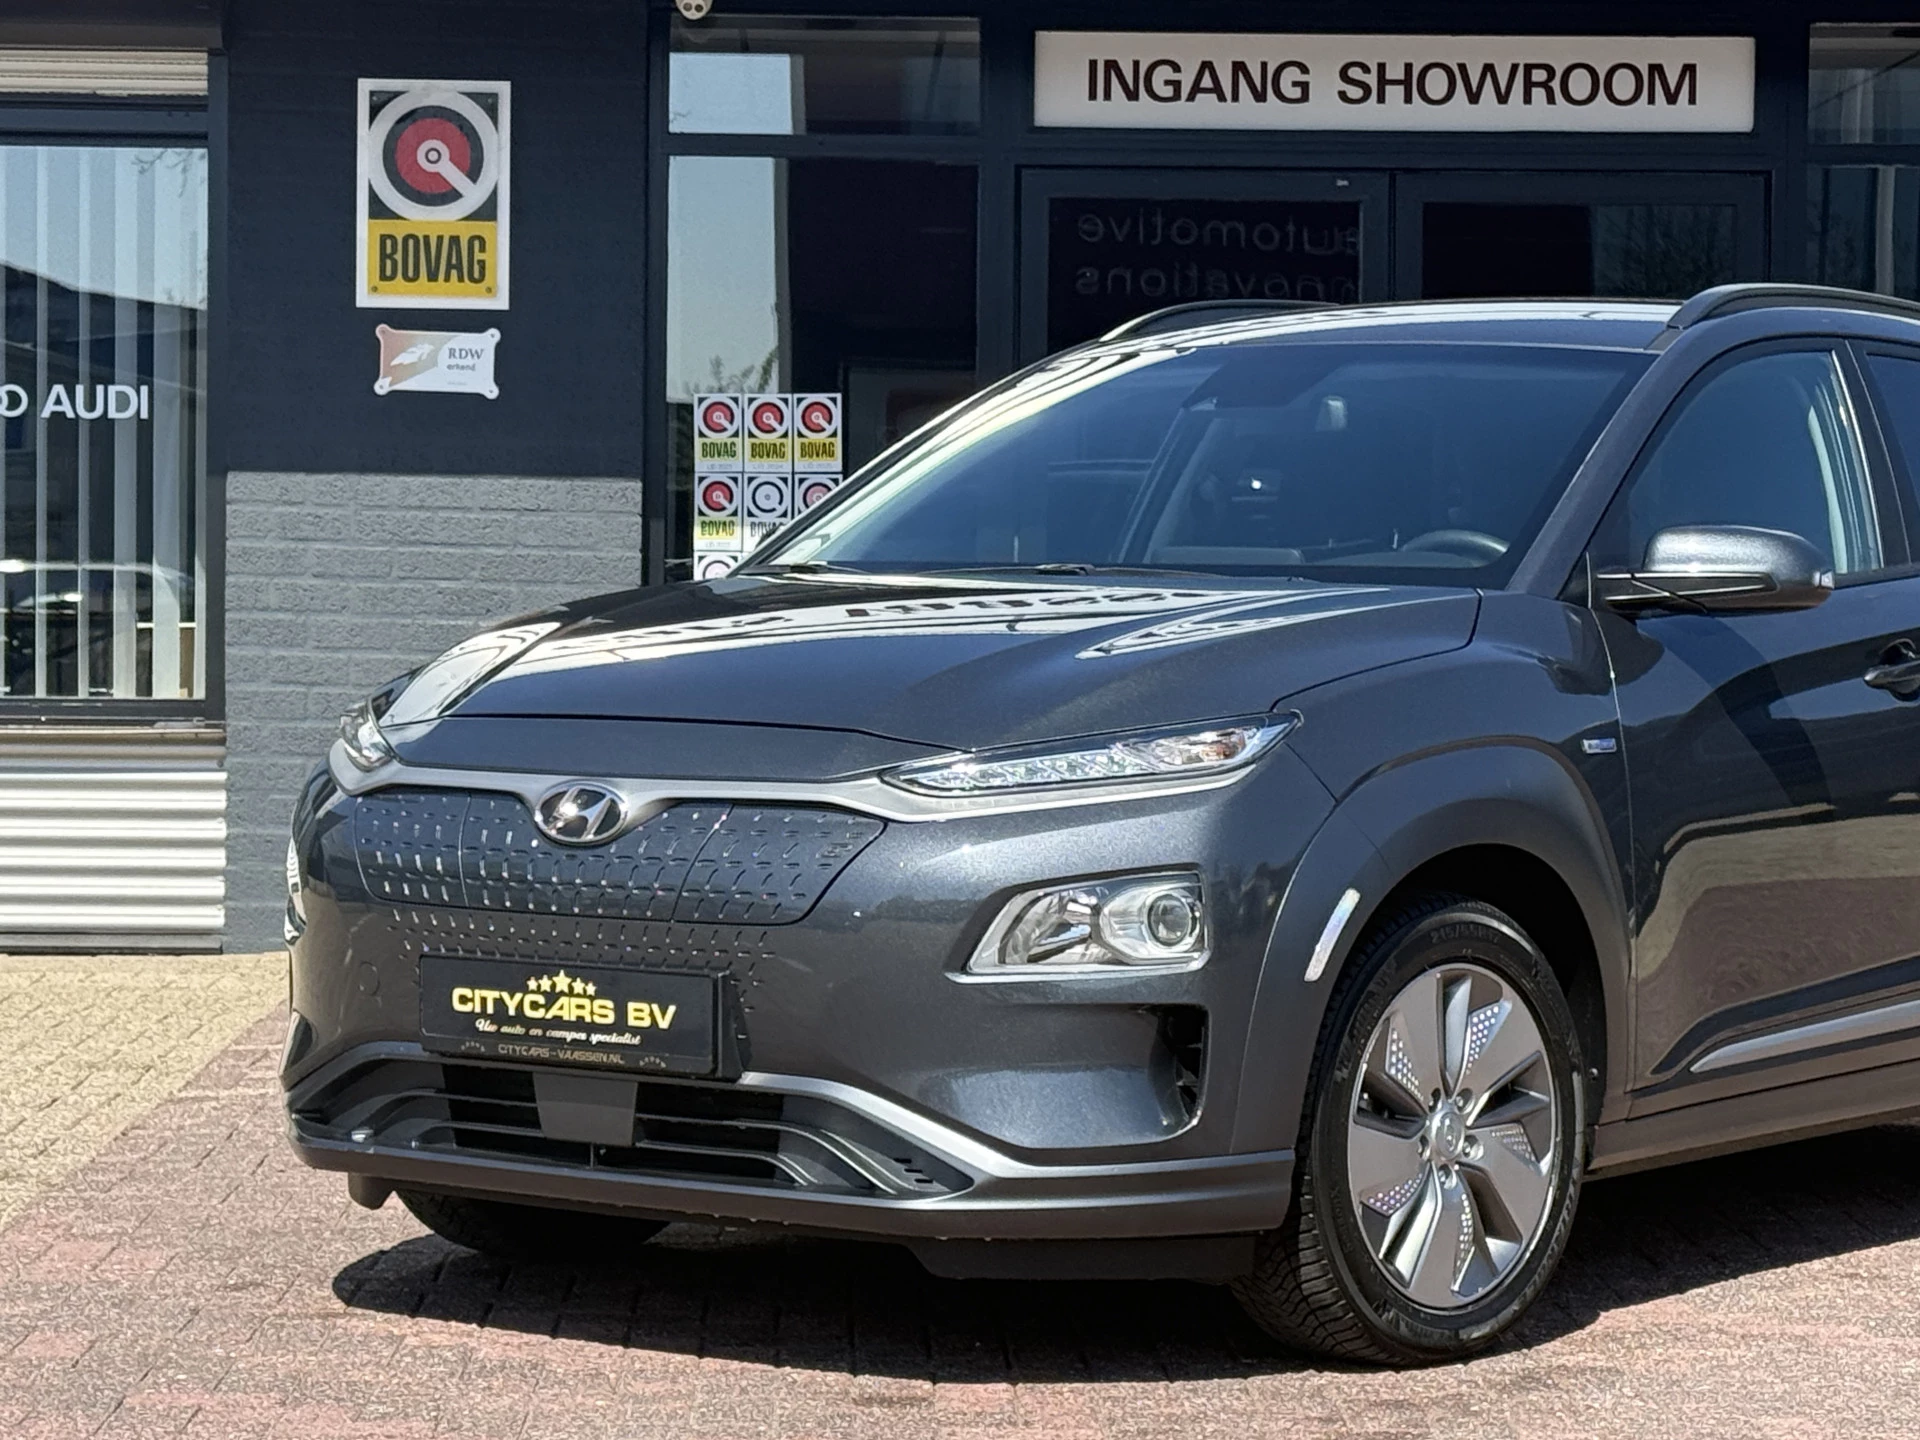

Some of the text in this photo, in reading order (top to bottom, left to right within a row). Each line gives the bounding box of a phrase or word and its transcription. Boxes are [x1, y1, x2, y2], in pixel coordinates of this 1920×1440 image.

[1088, 58, 1699, 107] INGANG SHOWROOM
[378, 233, 486, 284] BOVAG
[448, 347, 485, 360] RDW
[446, 362, 477, 372] erkend
[40, 384, 149, 420] AUDI
[701, 441, 737, 458] BOVAG
[751, 442, 786, 459] BOVAG
[800, 441, 835, 458] BOVAG
[701, 520, 735, 537] BOVAG
[451, 987, 677, 1030] CITYCARS BV
[500, 1024, 526, 1035] auto
[589, 1032, 641, 1046] specialist
